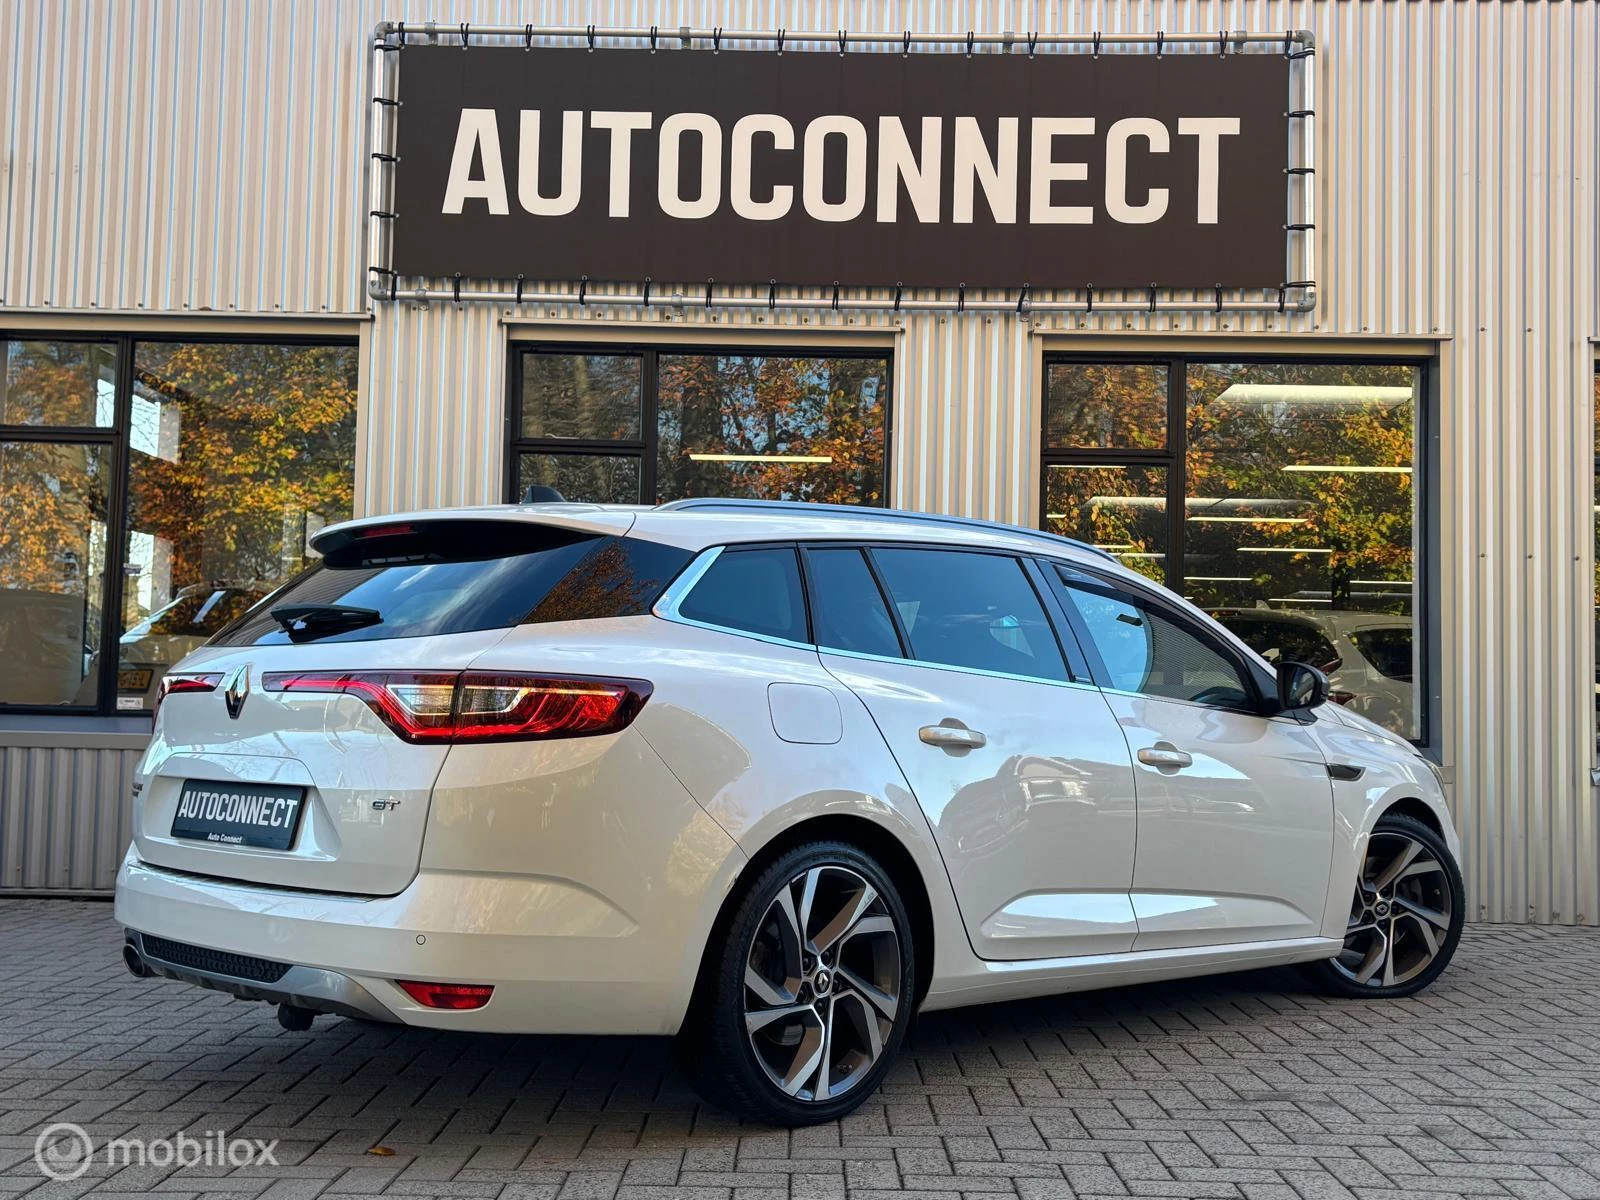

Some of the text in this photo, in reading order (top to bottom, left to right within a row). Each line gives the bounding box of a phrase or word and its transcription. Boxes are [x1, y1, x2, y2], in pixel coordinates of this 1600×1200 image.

[442, 107, 1241, 225] AUTOCONNECT
[178, 791, 298, 828] AUTOCONNECT
[372, 799, 401, 811] GT
[207, 832, 243, 843] Auto Connect
